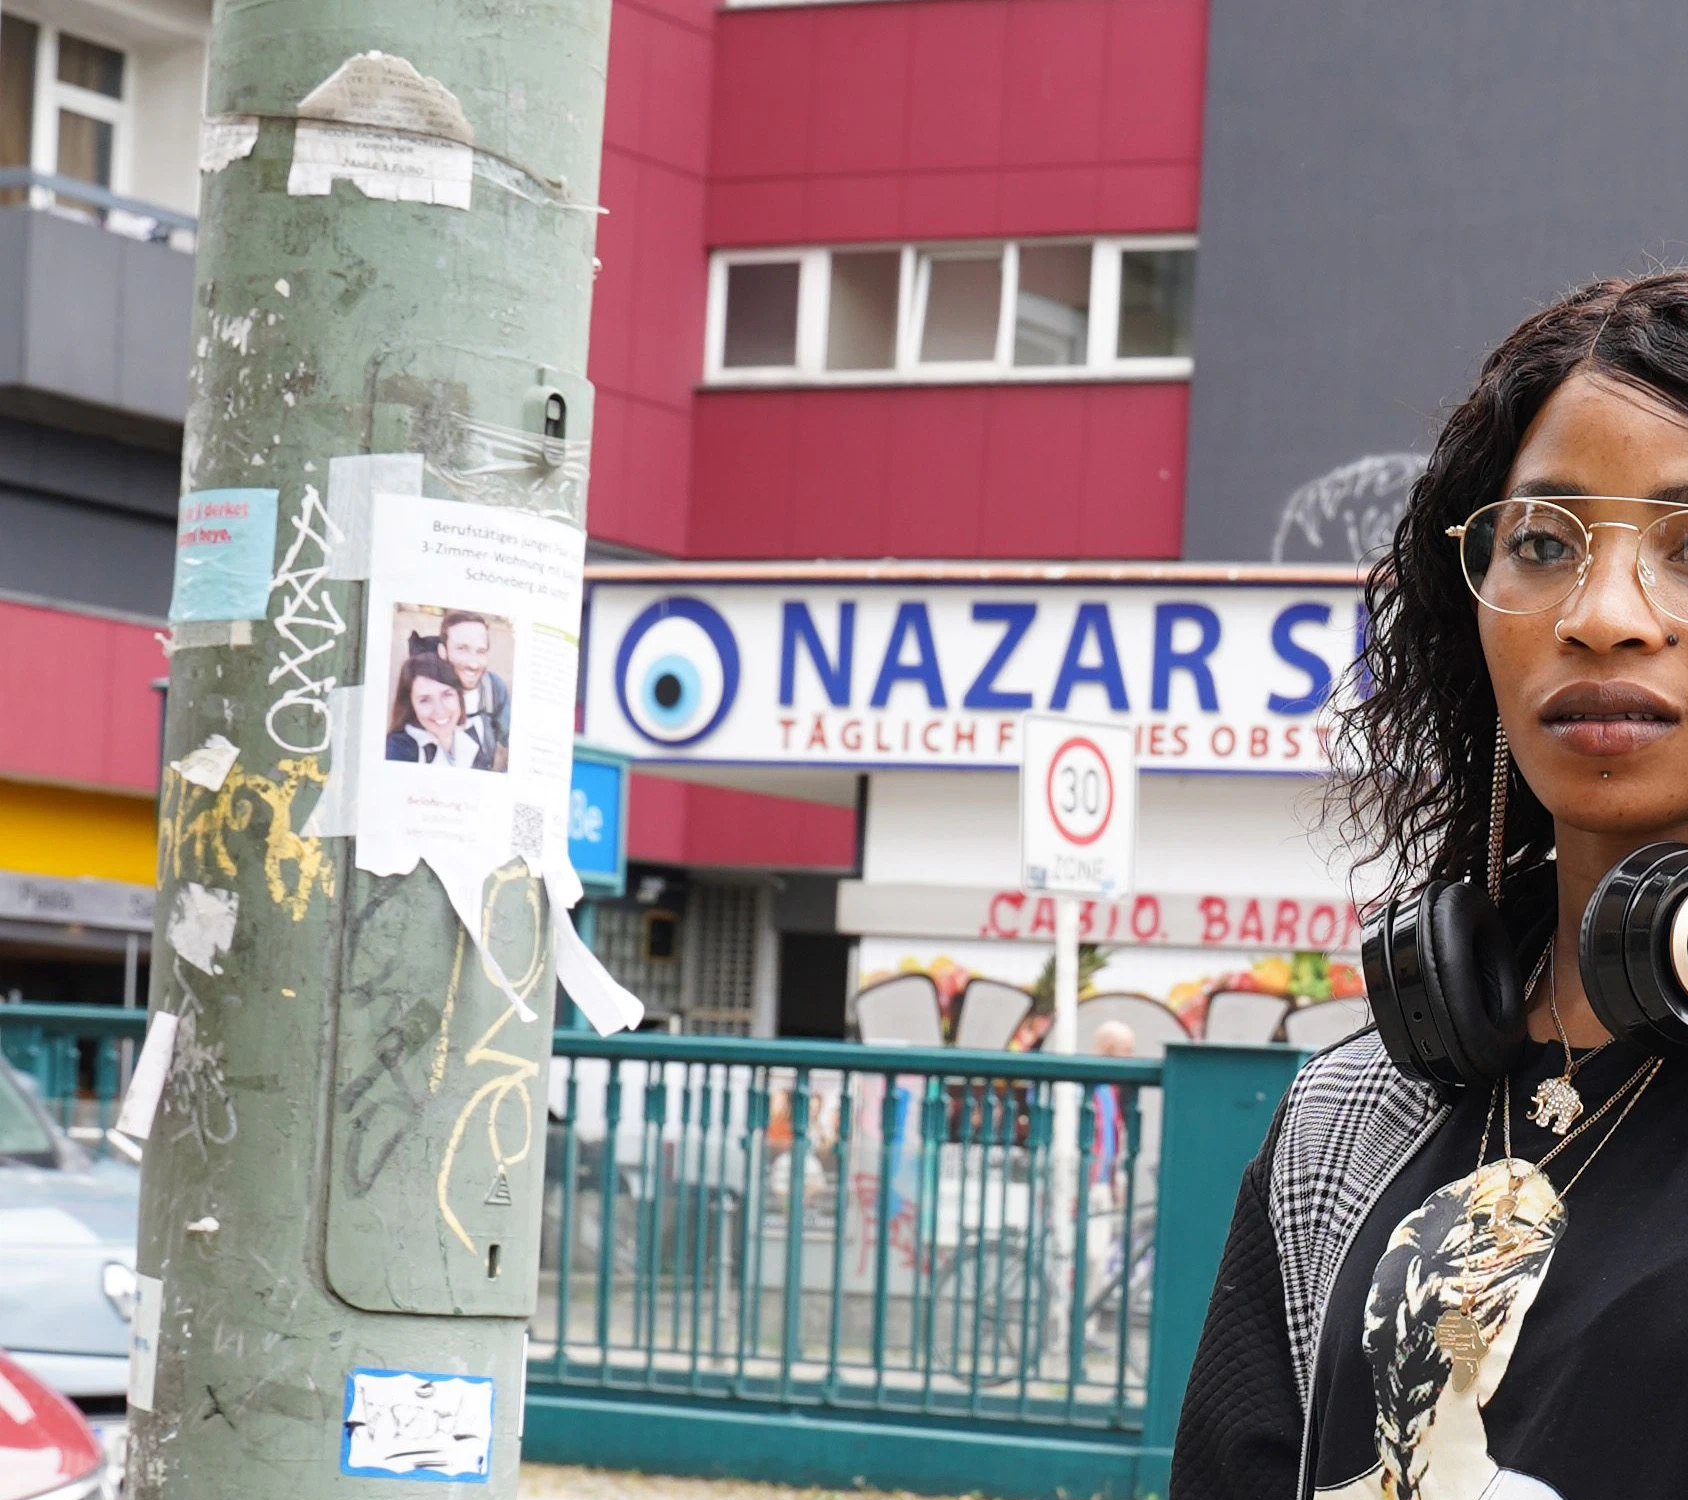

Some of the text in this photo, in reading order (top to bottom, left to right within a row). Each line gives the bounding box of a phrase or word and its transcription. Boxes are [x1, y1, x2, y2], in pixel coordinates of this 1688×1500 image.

[778, 600, 1222, 712] NAZAR
[779, 714, 976, 753] TÄGLICH
[1060, 766, 1100, 816] 30
